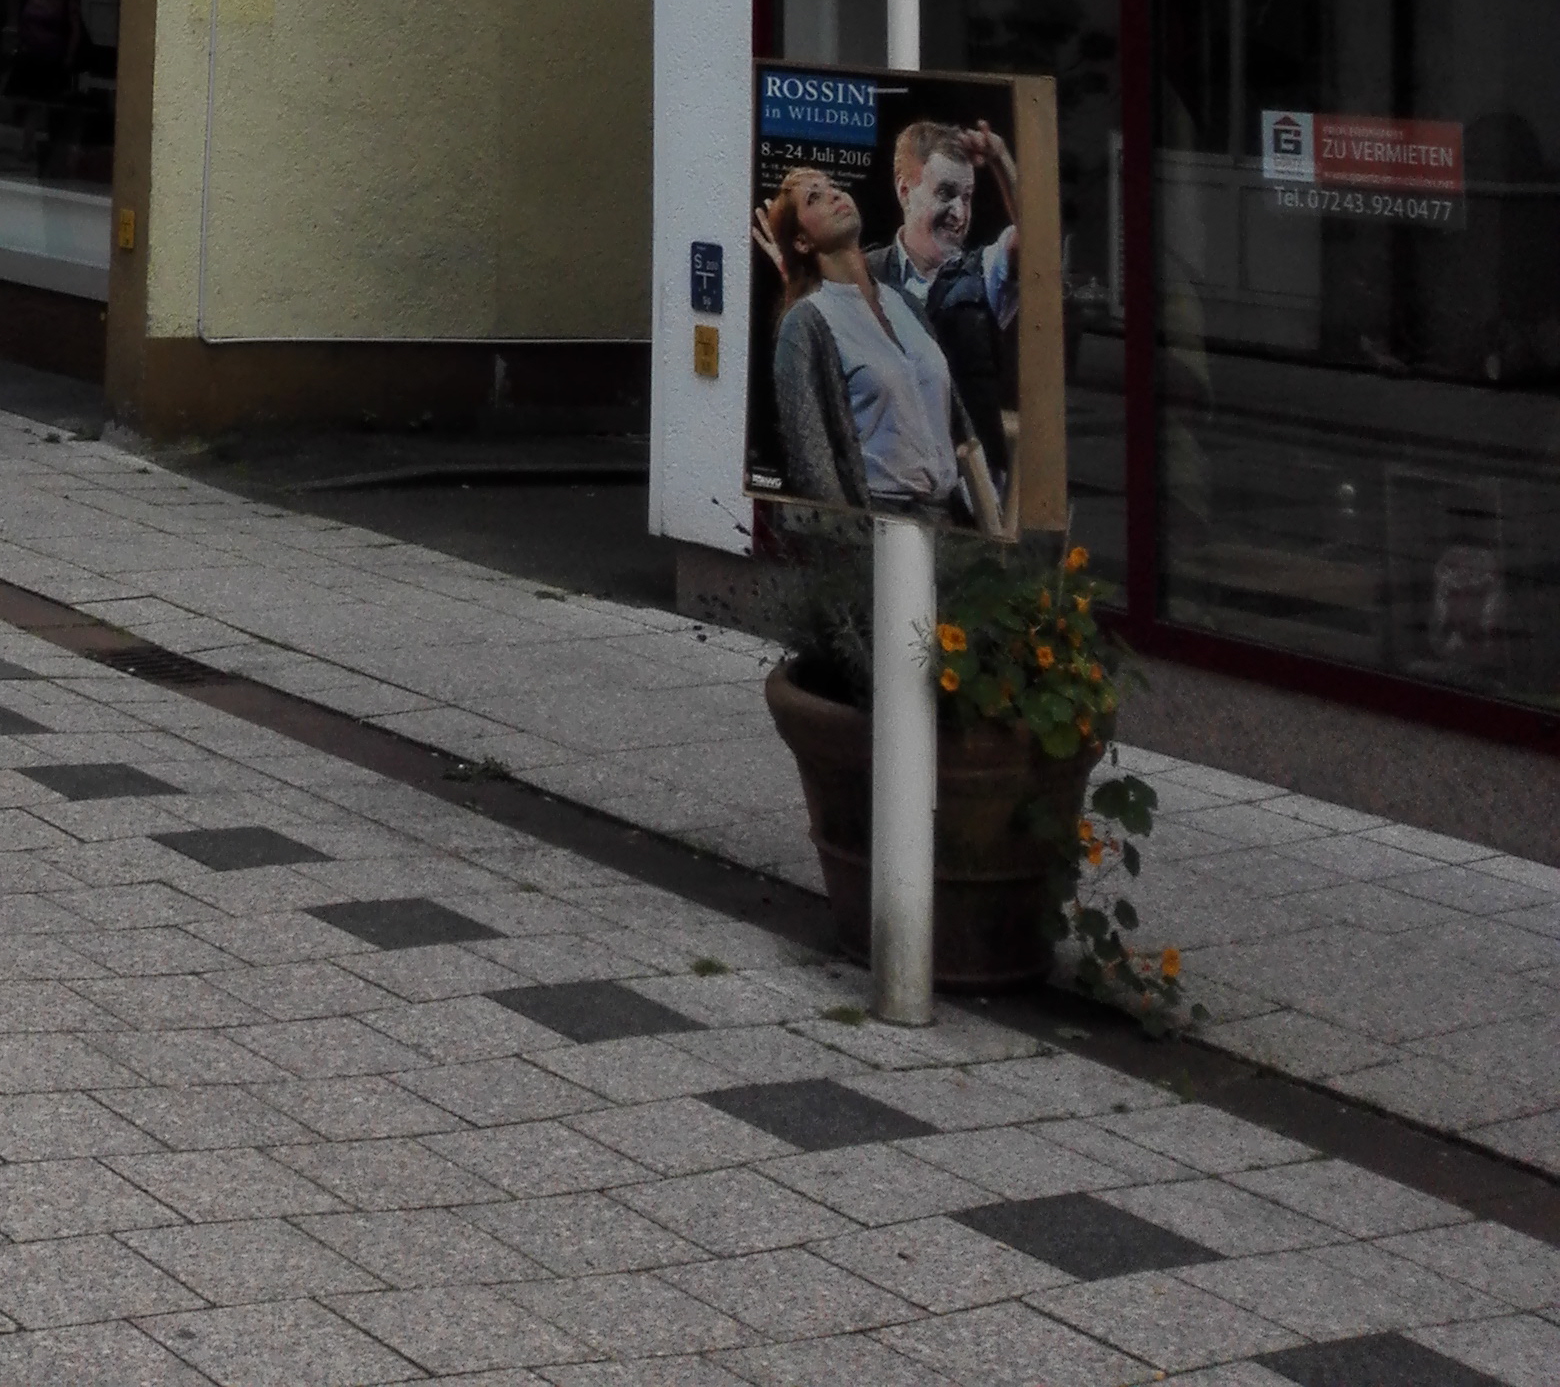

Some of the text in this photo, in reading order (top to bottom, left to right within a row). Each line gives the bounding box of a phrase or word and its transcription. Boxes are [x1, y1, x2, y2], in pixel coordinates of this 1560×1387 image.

[765, 76, 876, 107] ROSSINI
[764, 104, 876, 128] in WILDBAD
[810, 146, 835, 163] Juli
[839, 149, 872, 167] 2016
[1322, 138, 1454, 168] ZU VERMIETEN
